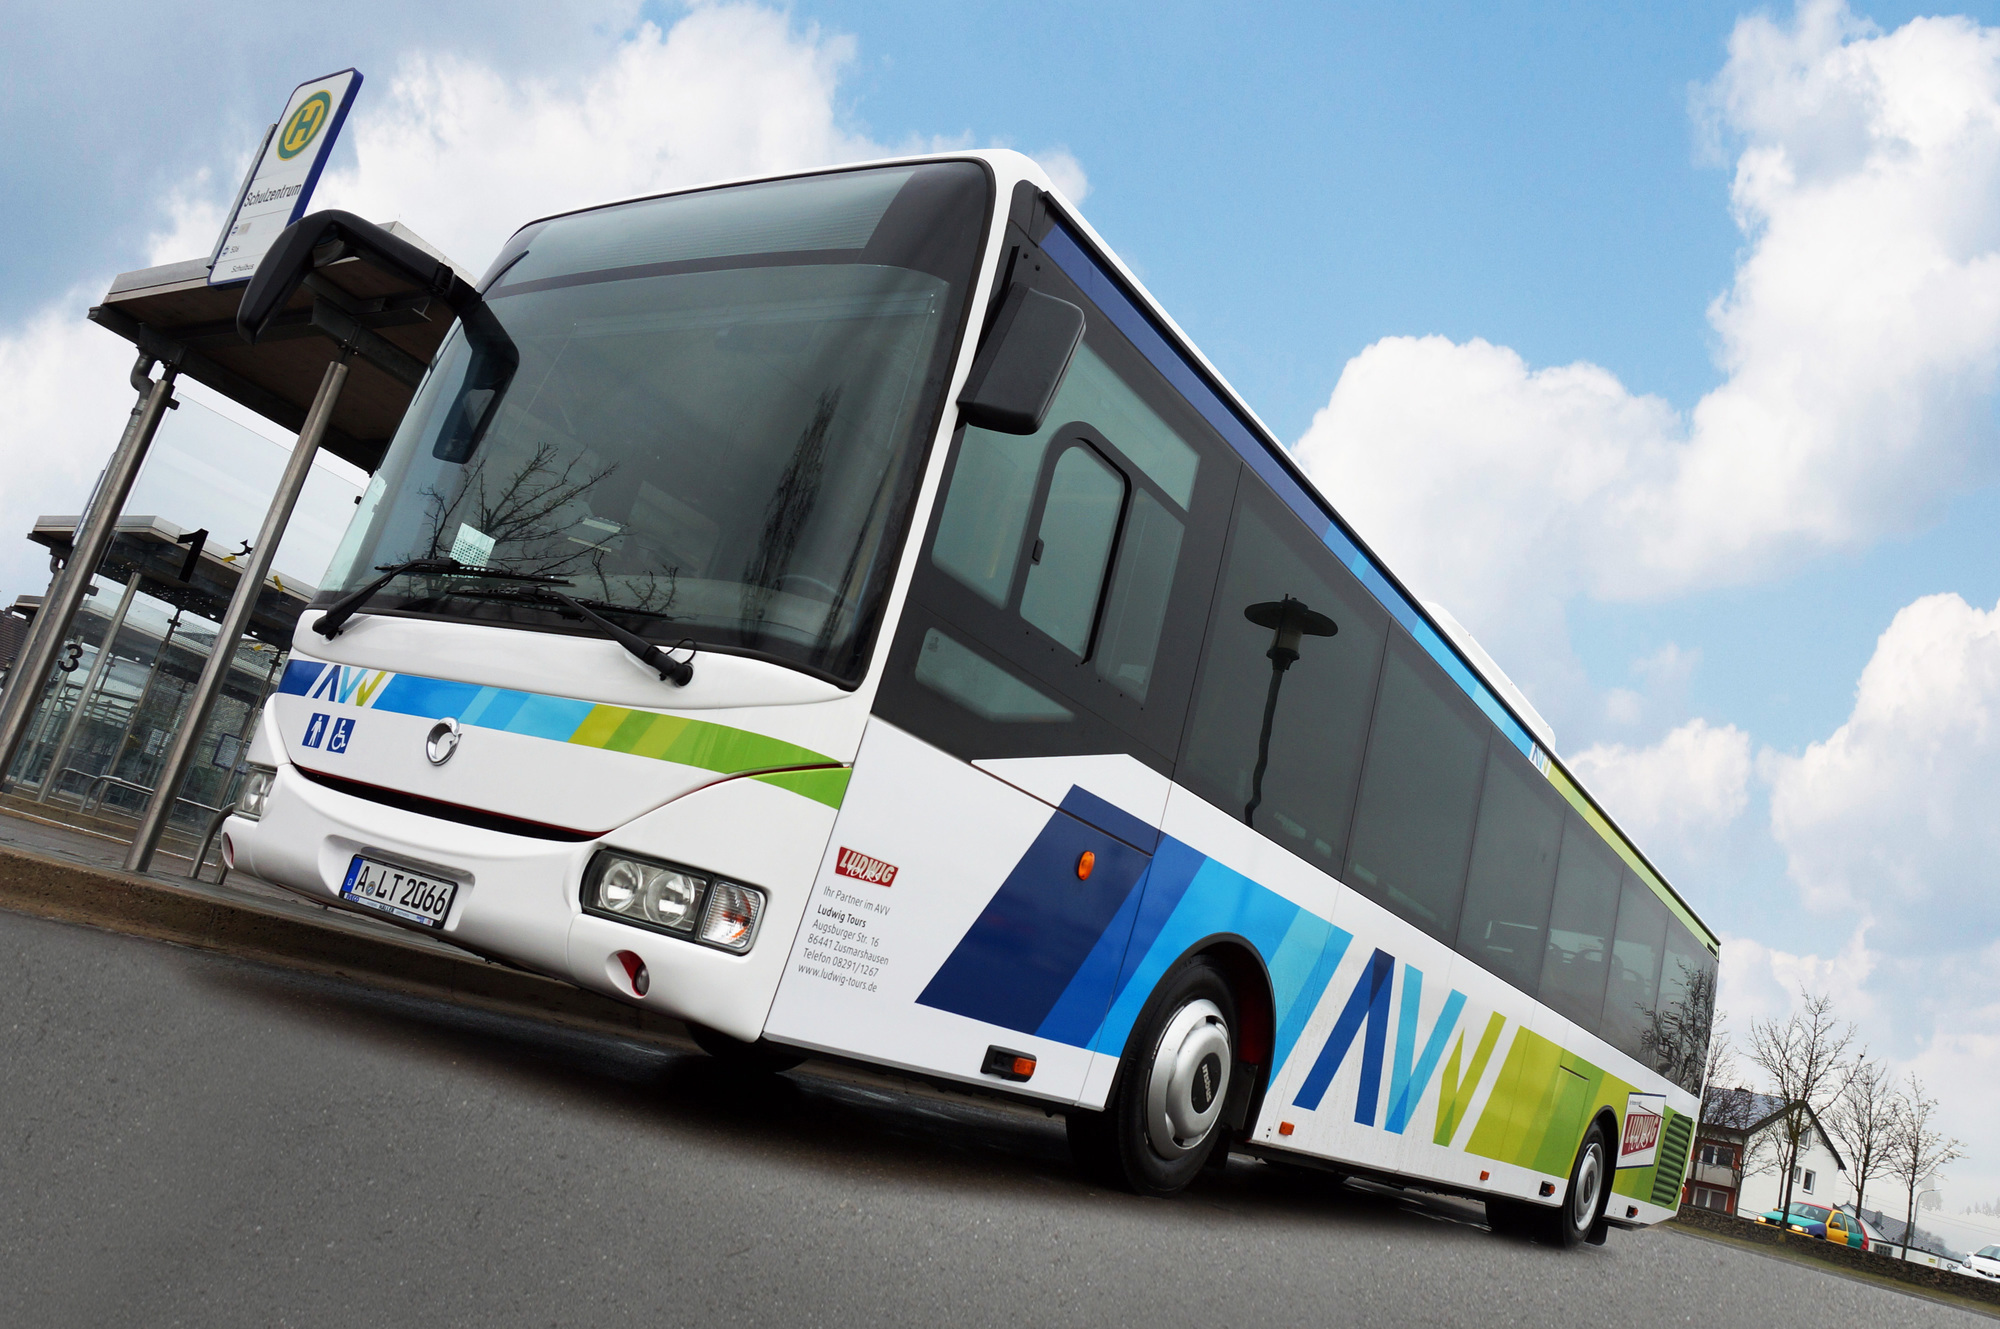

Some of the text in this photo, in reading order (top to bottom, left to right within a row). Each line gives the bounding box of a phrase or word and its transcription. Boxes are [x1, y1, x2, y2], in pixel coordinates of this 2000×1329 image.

[287, 105, 321, 145] H
[244, 183, 302, 207] Schulzentrum
[177, 528, 209, 583] 1
[57, 644, 84, 672] 3
[839, 850, 895, 884] LUDWIG
[347, 878, 353, 886] D
[355, 866, 447, 915] A LT 2066
[823, 886, 891, 916] Ihr Partner im AVV
[817, 904, 866, 928] Ludwig Tours
[812, 919, 880, 947] Augsburger Str. 16
[803, 948, 879, 977] Telefon 08291/1267
[807, 934, 889, 965] 86441 Zusmarshausen
[798, 964, 878, 992] www.ludwig-tours.de
[1625, 1115, 1659, 1144] LUDWIG
